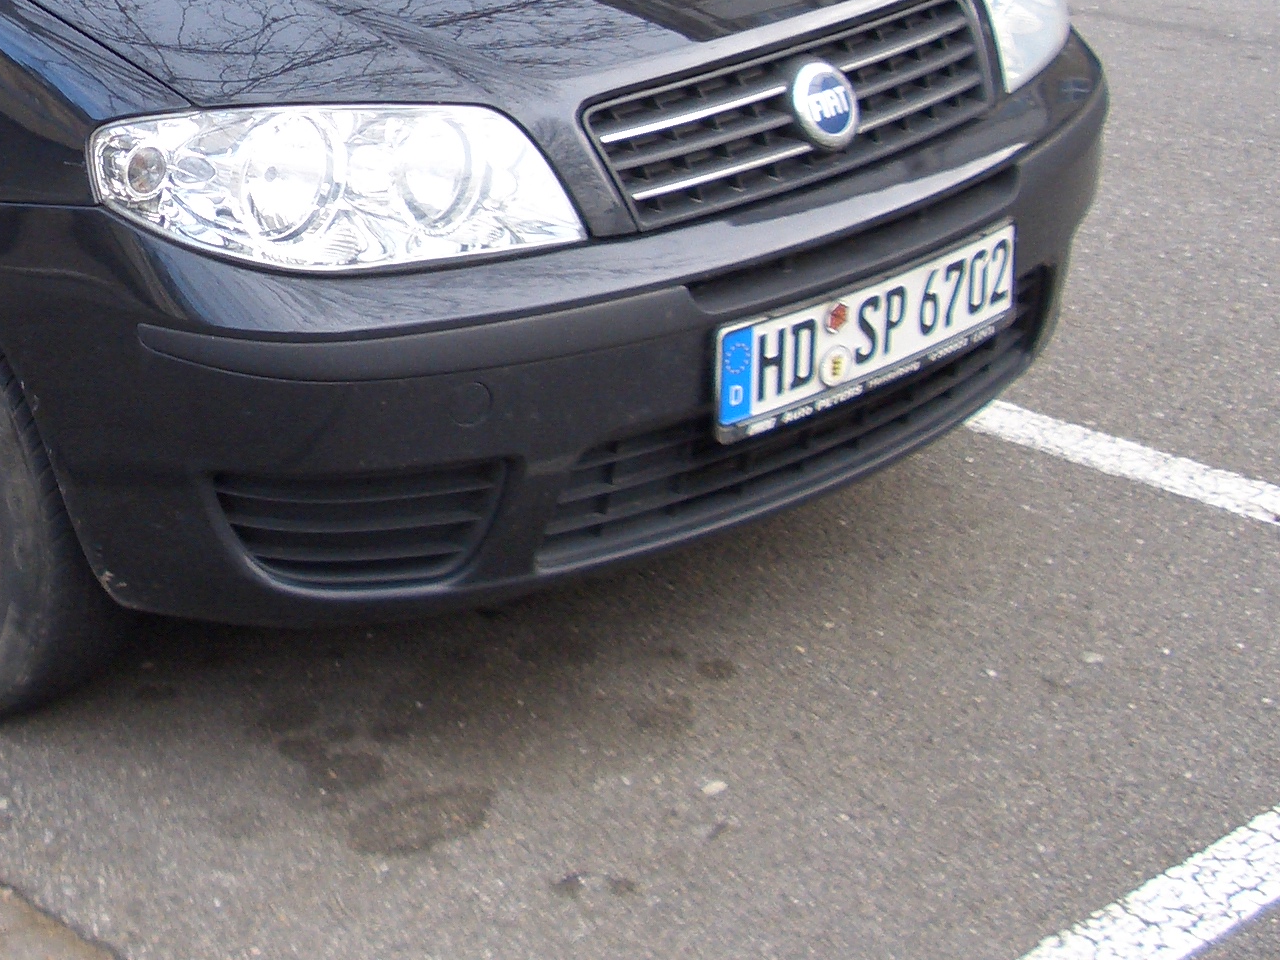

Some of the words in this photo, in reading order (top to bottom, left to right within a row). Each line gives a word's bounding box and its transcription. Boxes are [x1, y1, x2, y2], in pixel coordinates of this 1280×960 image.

[807, 85, 849, 122] FIAT
[757, 318, 818, 402] HD
[856, 285, 907, 365] SP
[920, 239, 1010, 337] 6702
[729, 385, 743, 406] D
